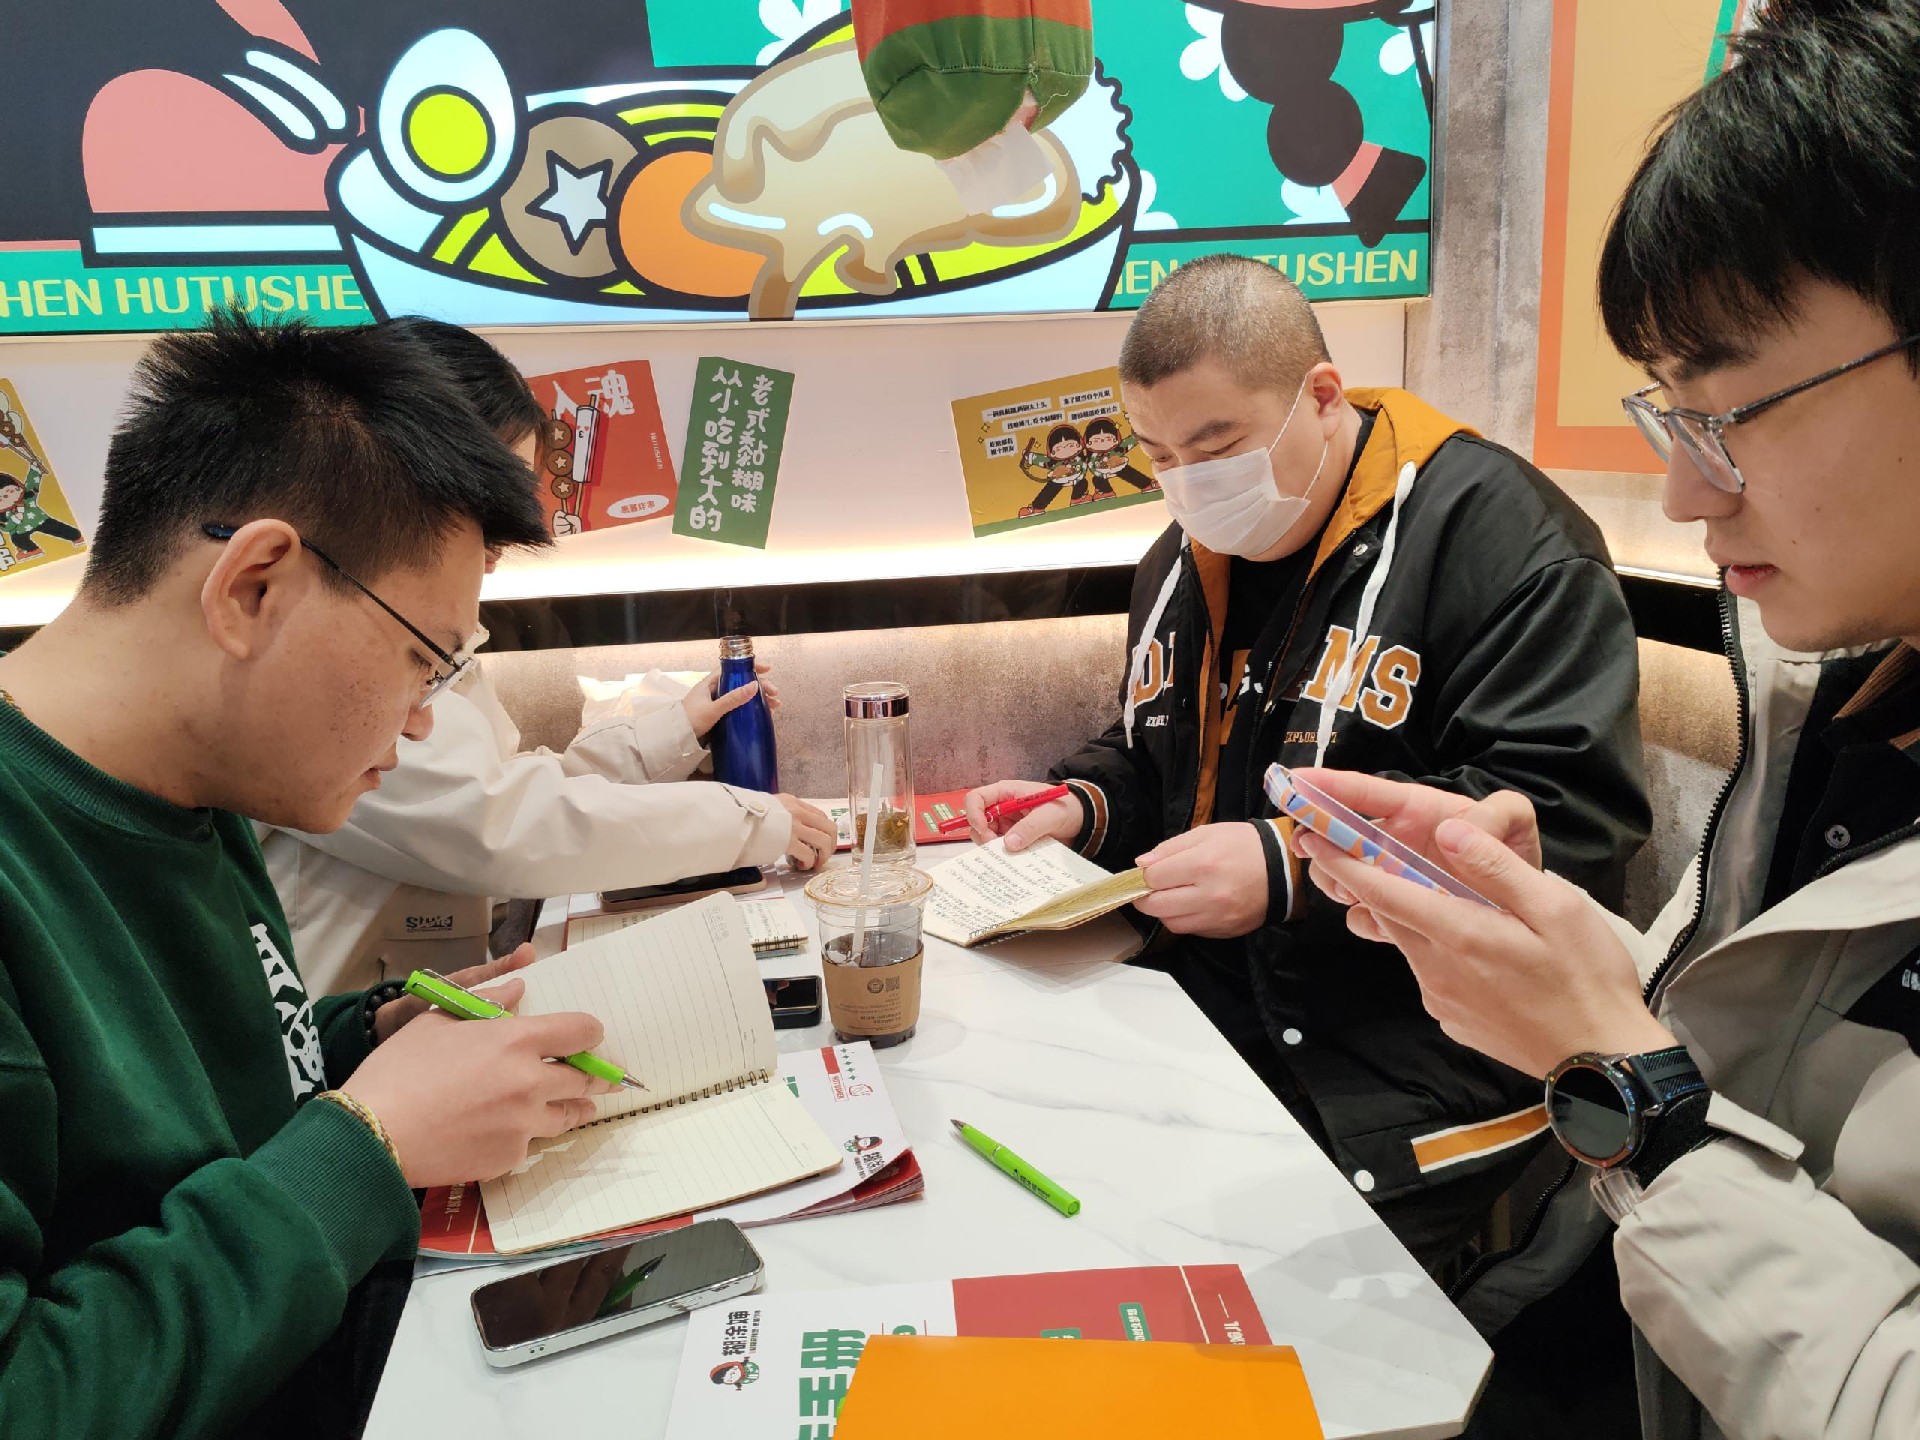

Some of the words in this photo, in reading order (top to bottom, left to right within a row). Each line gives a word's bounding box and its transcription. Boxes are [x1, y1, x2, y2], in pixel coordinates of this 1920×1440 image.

[115, 274, 371, 315] HUTUSHE
[689, 365, 743, 533] 从小吃到大的
[721, 1310, 751, 1357] 糊涂婶
